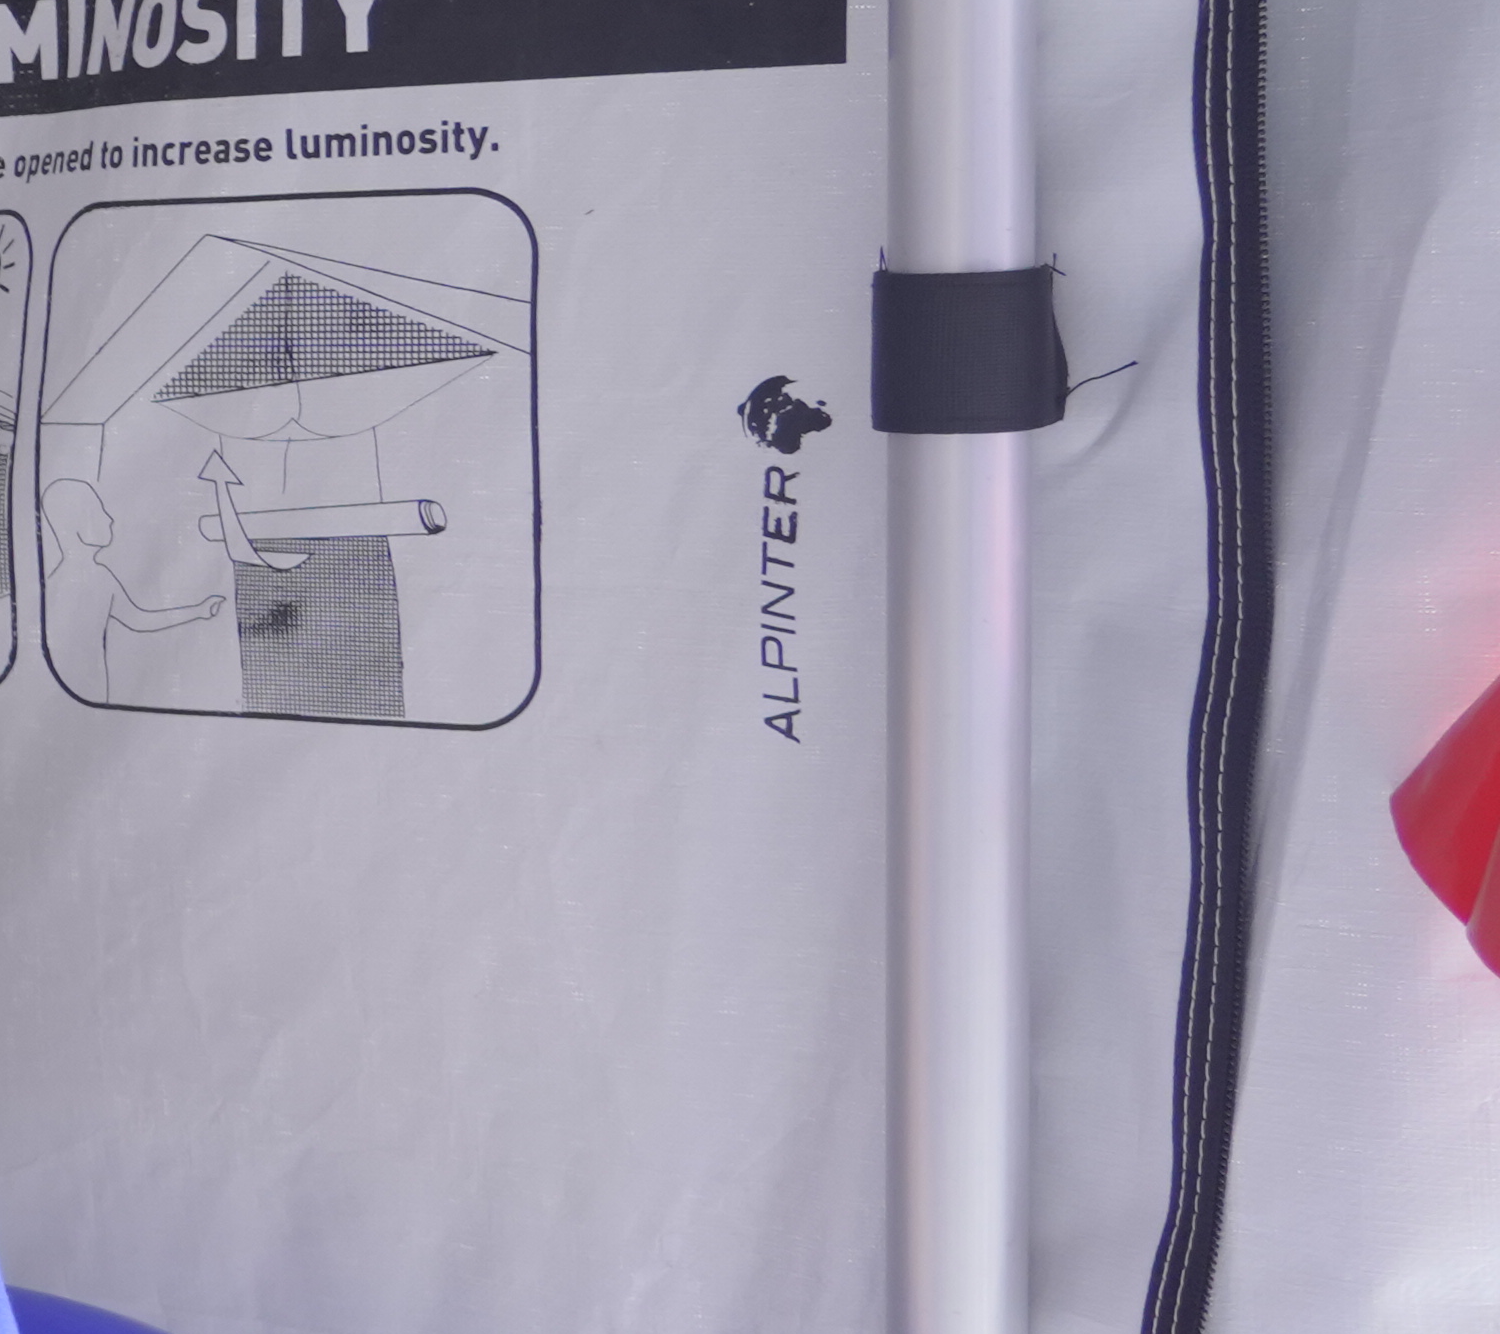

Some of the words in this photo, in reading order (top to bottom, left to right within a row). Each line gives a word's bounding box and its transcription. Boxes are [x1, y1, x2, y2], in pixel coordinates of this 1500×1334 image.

[13, 140, 95, 184] opened
[101, 141, 124, 169] to
[131, 135, 274, 169] increase
[284, 120, 501, 161] luminosity.
[760, 465, 802, 745] ALPINTER
